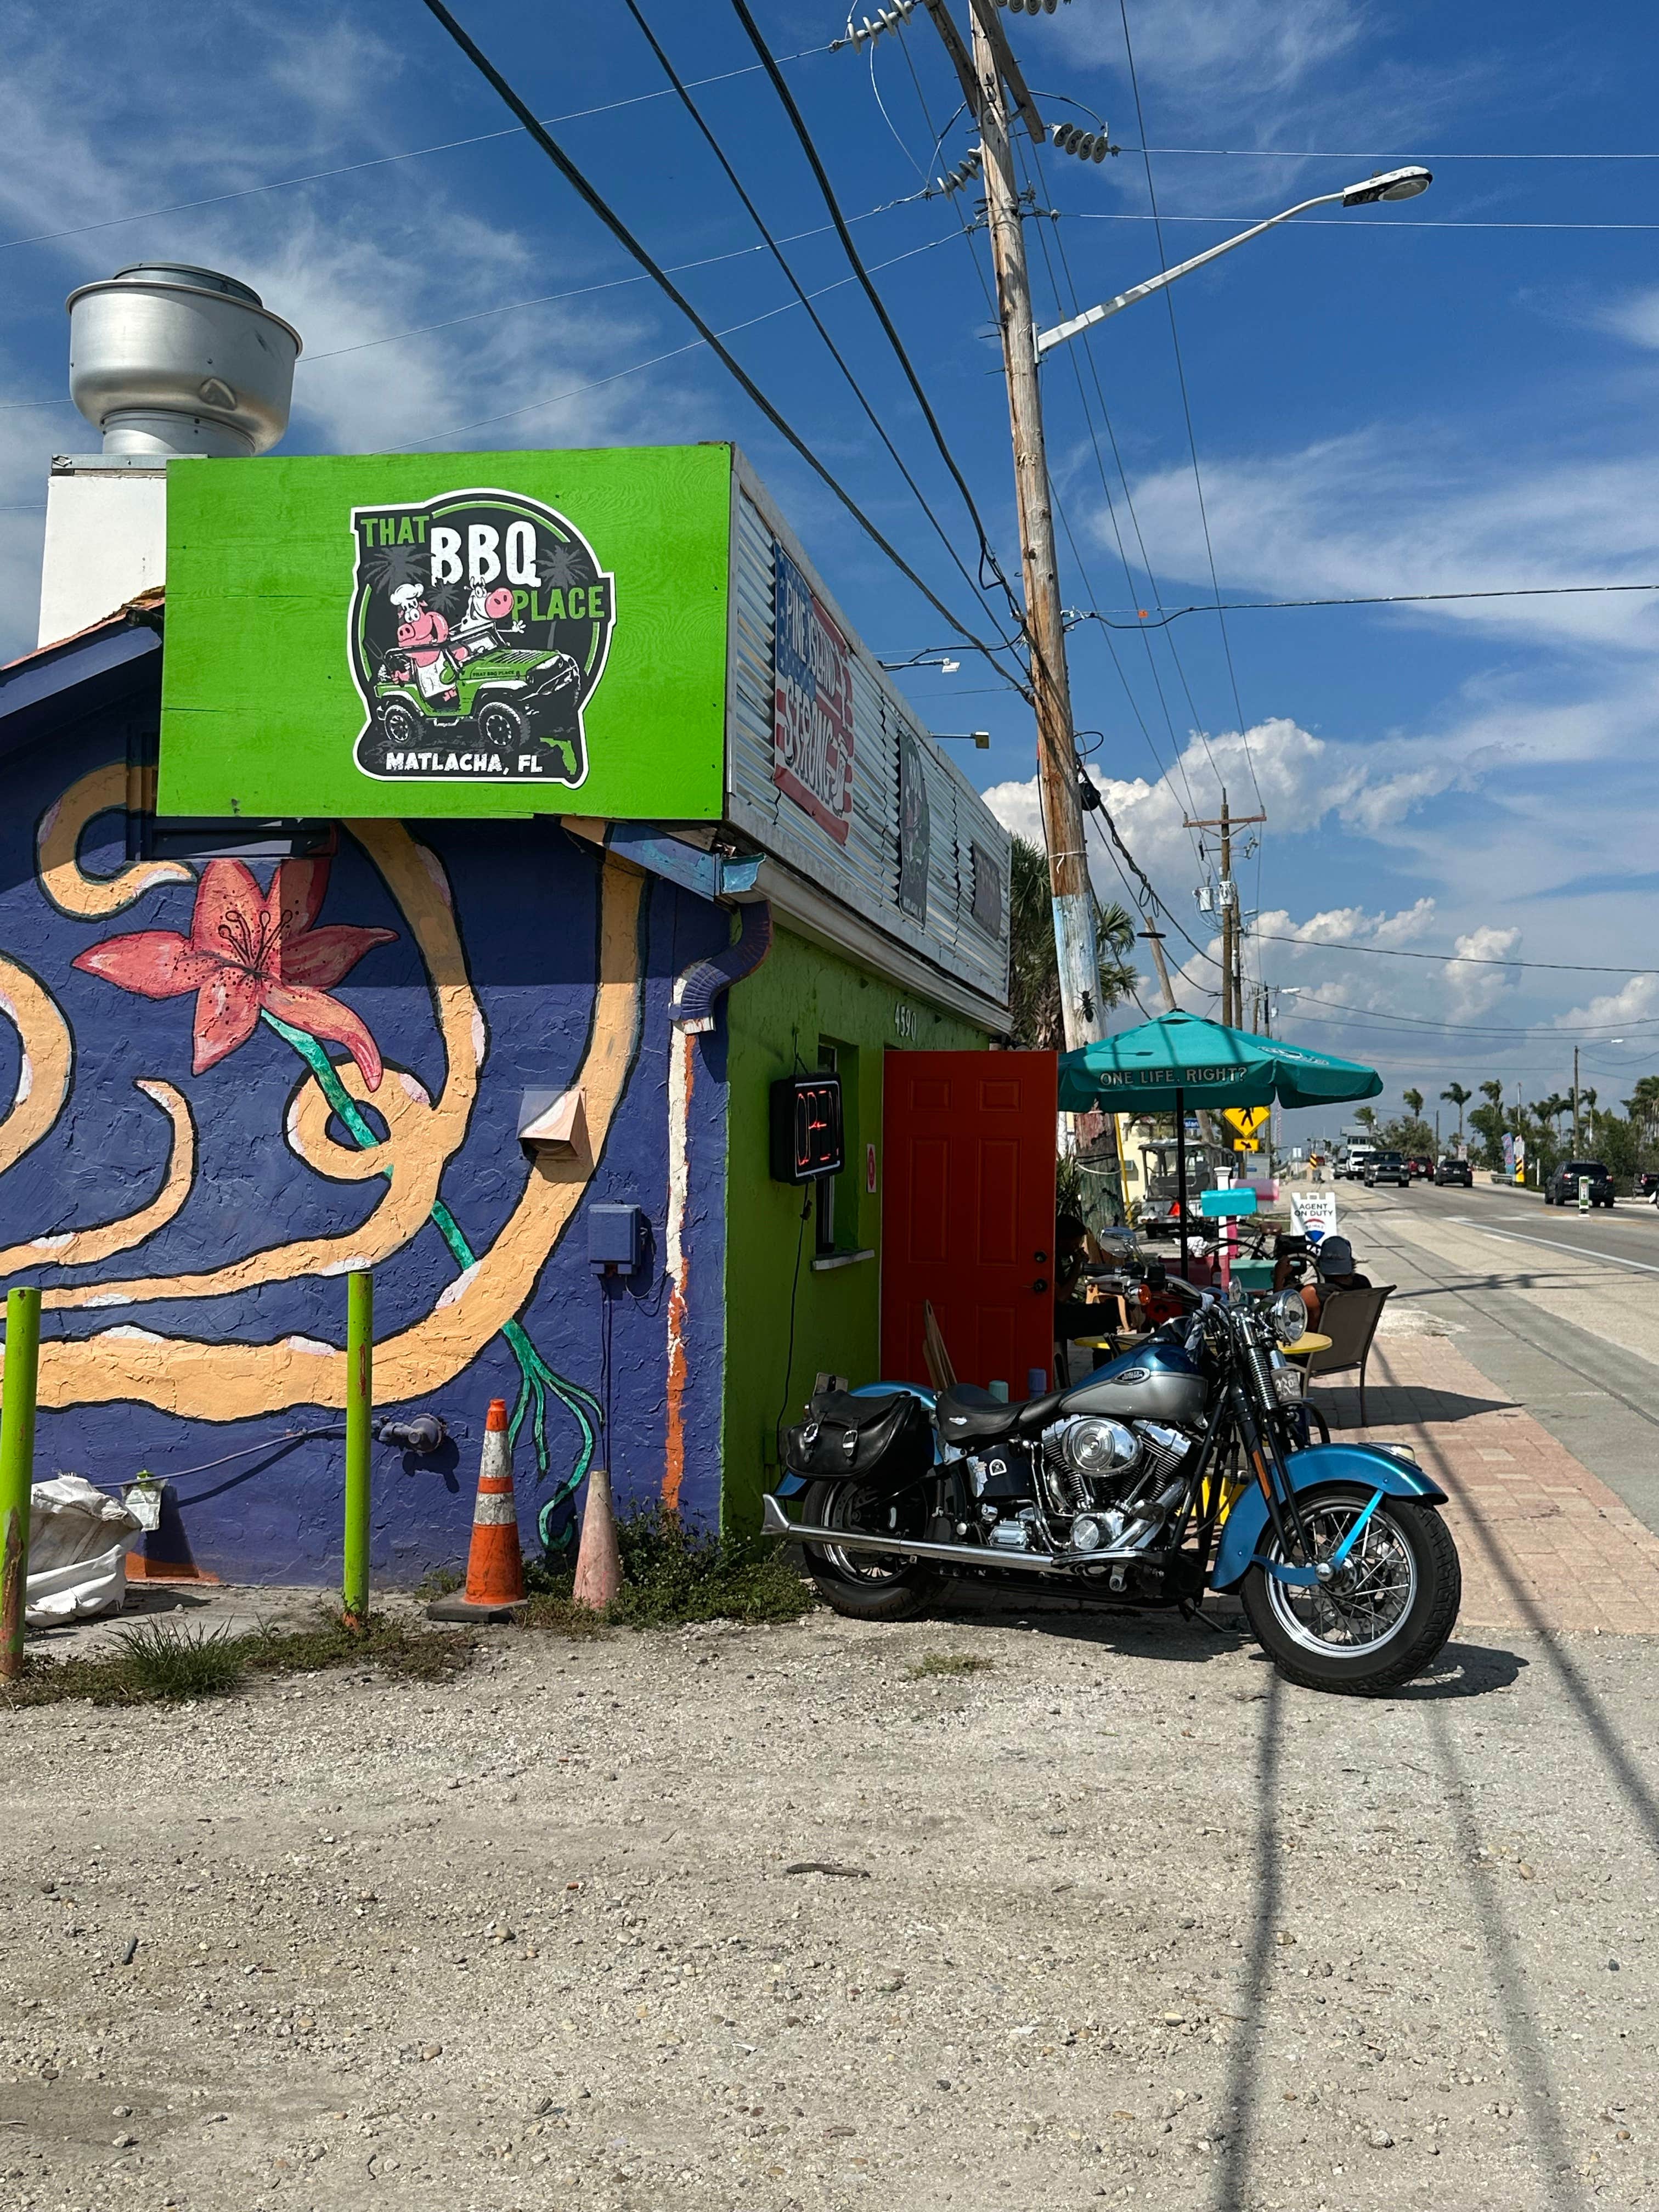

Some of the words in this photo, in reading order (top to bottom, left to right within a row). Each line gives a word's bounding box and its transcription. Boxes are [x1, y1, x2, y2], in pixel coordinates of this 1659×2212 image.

[360, 515, 430, 548] THAT
[431, 520, 541, 588] BBQ
[512, 585, 605, 623] PLACE
[785, 579, 806, 665] PINE
[806, 611, 838, 699] ISLAND
[784, 675, 833, 805] STRONG
[386, 752, 510, 776] MATLACHA,
[518, 754, 543, 773] FL
[895, 1002, 917, 1041] 4590
[1100, 1071, 1133, 1086] ONE
[1141, 1070, 1180, 1084] LIFE,
[1186, 1067, 1247, 1083] RIGHT?
[796, 1090, 839, 1166] OPEN
